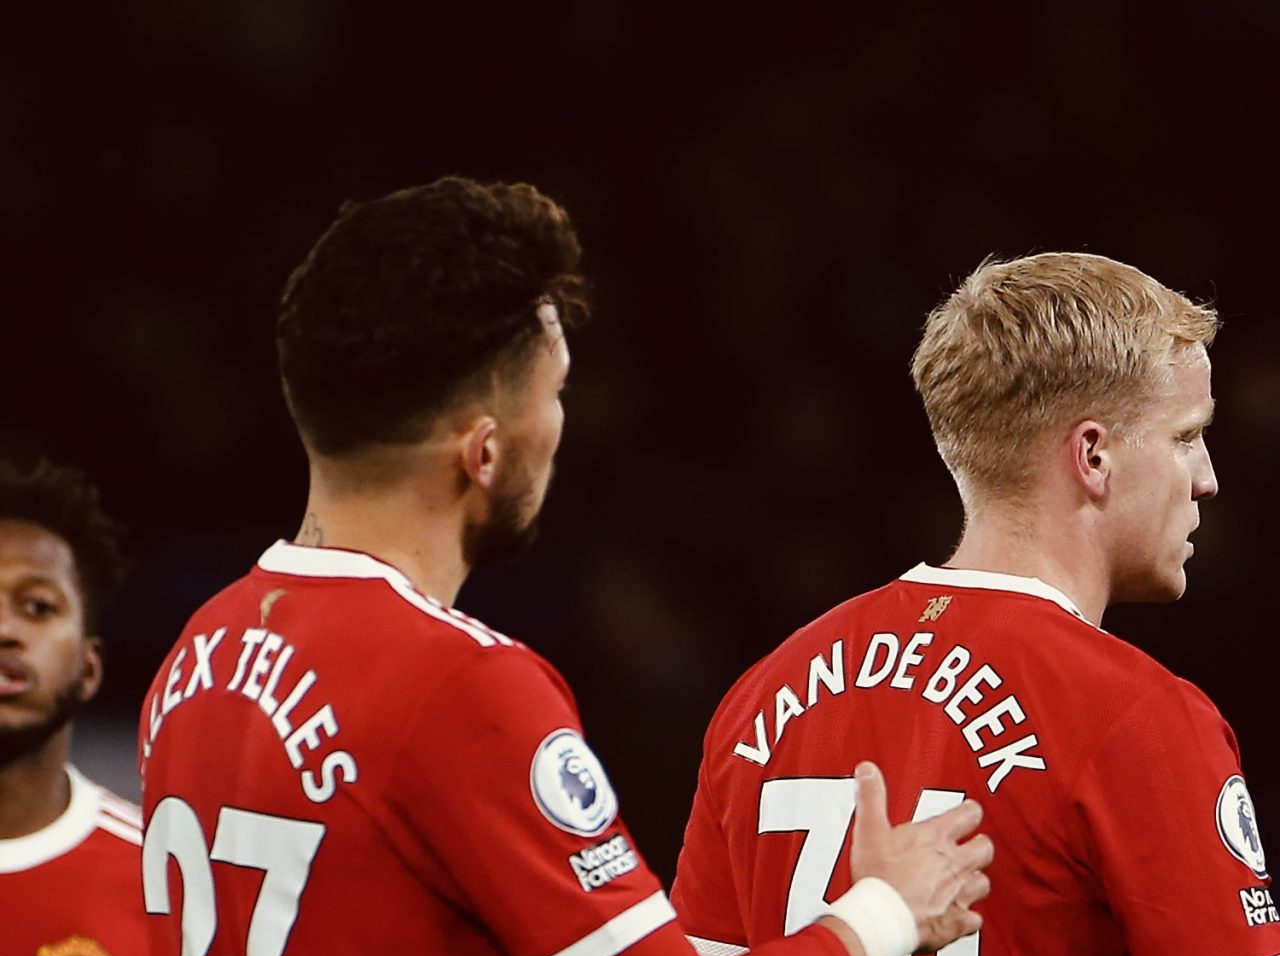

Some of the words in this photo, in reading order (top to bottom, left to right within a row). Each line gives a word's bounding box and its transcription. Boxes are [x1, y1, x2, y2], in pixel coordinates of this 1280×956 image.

[141, 627, 228, 775] LEX
[226, 627, 358, 804] TELLES
[732, 638, 847, 768] VAN
[854, 632, 935, 690] DE
[921, 644, 1048, 795] BEEK
[1239, 887, 1266, 909] No
[1245, 906, 1268, 927] For
